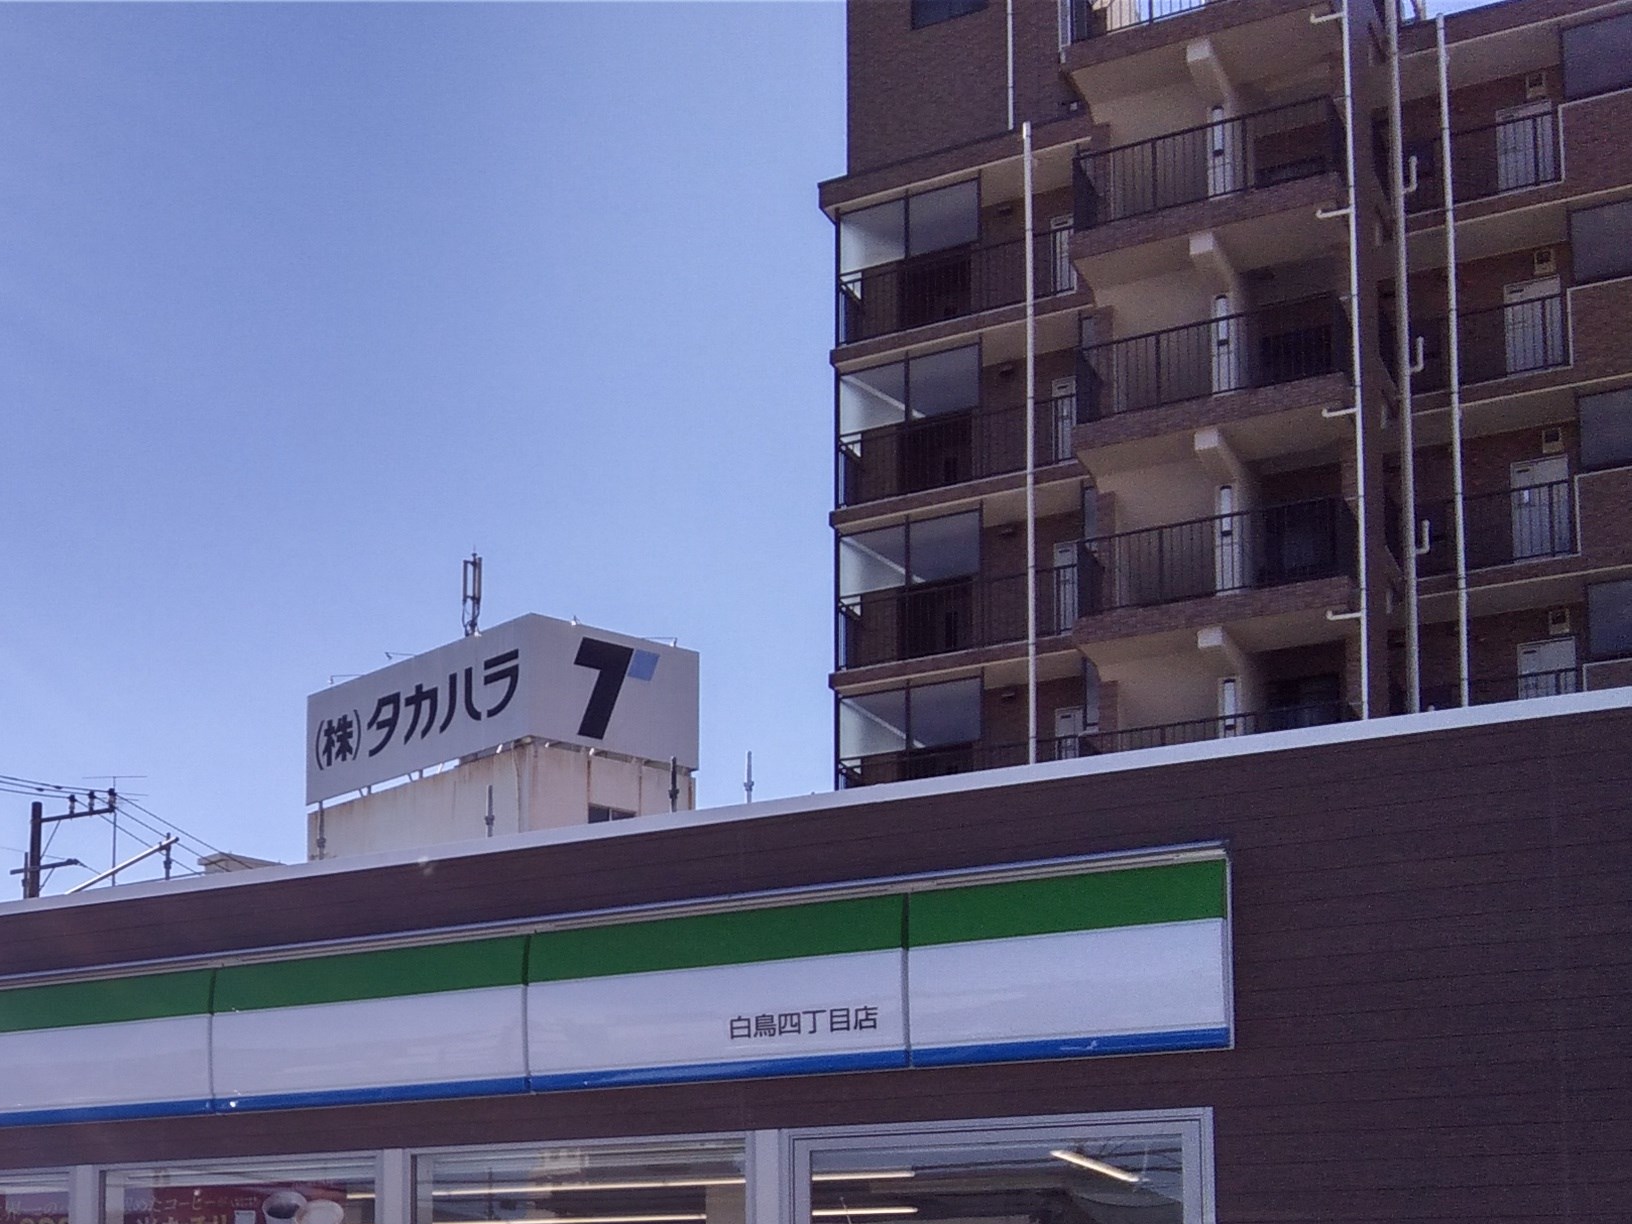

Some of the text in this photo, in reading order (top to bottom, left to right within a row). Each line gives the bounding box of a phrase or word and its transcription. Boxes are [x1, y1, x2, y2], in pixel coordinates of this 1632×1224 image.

[315, 648, 519, 770] (株)タカハラ
[729, 1005, 878, 1040] 白鳥四丁目店
